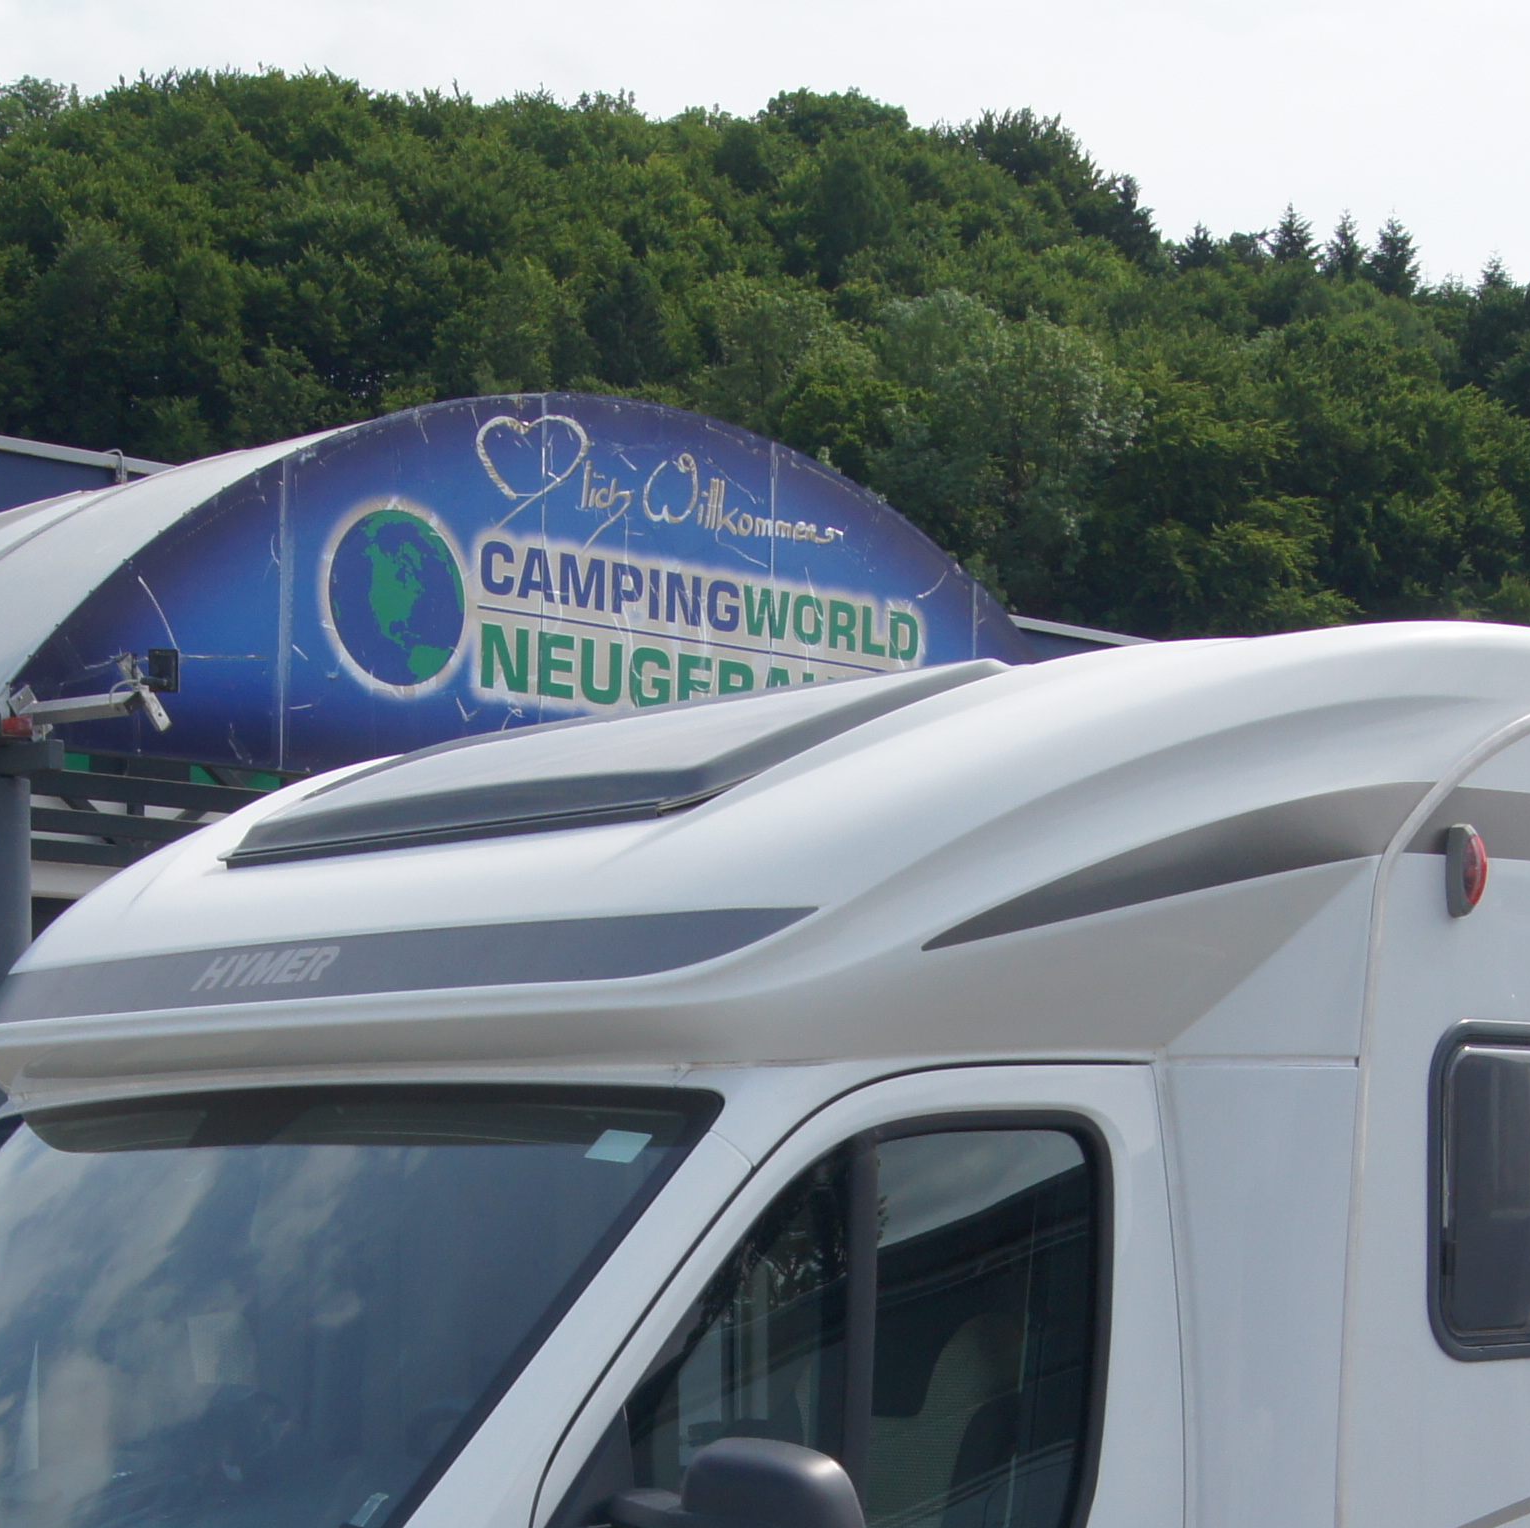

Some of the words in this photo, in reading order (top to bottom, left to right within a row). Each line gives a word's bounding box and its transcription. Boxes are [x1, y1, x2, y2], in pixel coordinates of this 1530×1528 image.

[643, 453, 844, 544] Willkommen
[480, 540, 920, 661] CAMPINGWORLD
[480, 622, 843, 708] NEUGEB
[190, 946, 340, 992] HYMER
